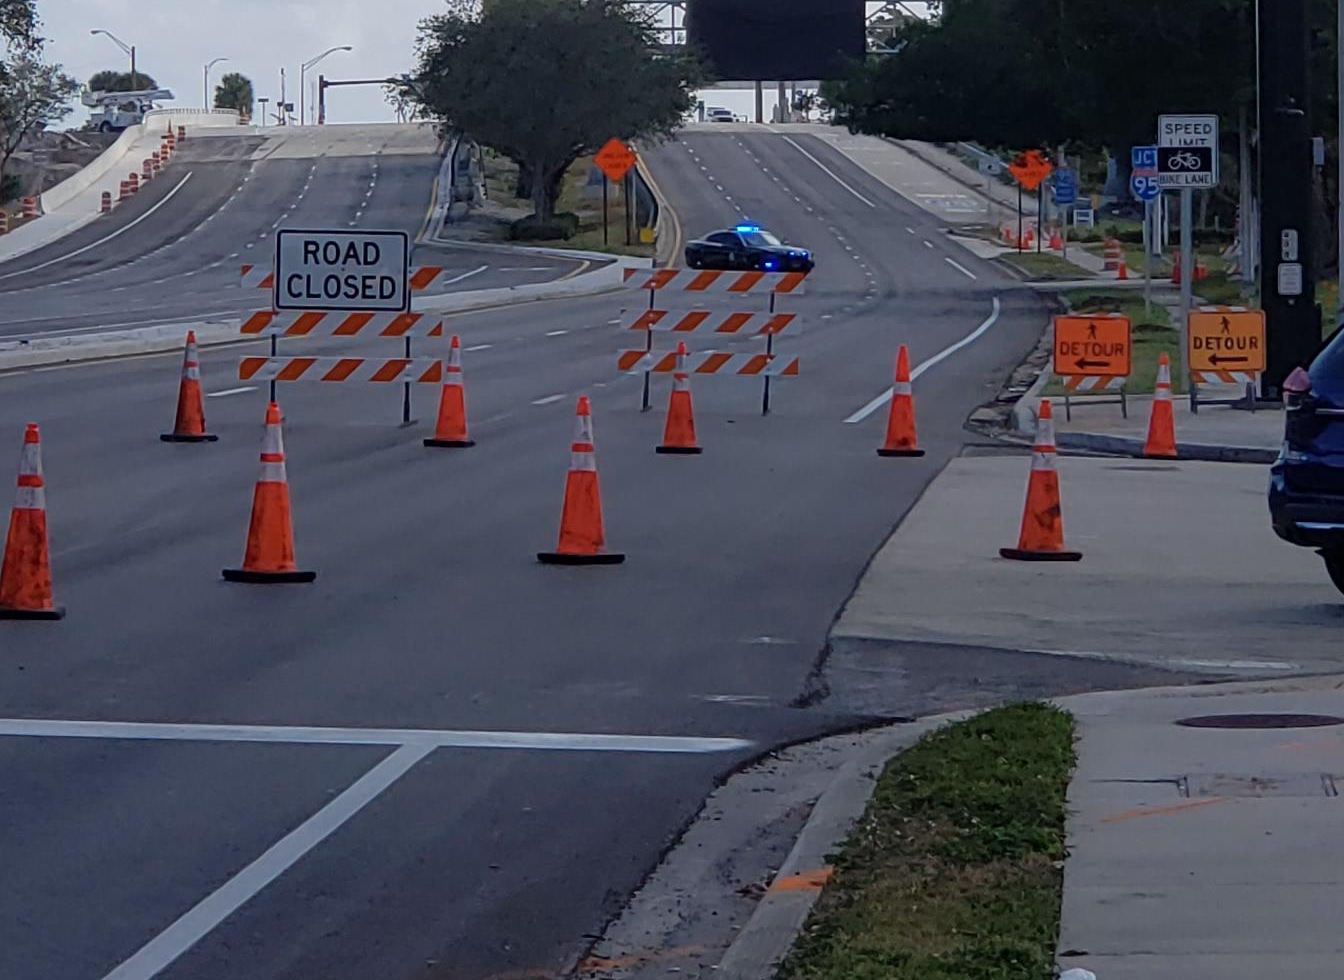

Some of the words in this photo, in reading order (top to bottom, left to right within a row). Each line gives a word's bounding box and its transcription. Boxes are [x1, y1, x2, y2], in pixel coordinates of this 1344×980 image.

[1165, 123, 1212, 135] SPEED
[1134, 177, 1160, 195] 95
[1185, 174, 1210, 185] LANE
[303, 240, 381, 266] ROAD
[287, 273, 396, 299] CLOSED
[1060, 341, 1125, 356] DETOUR
[1192, 336, 1259, 351] DETOUR
